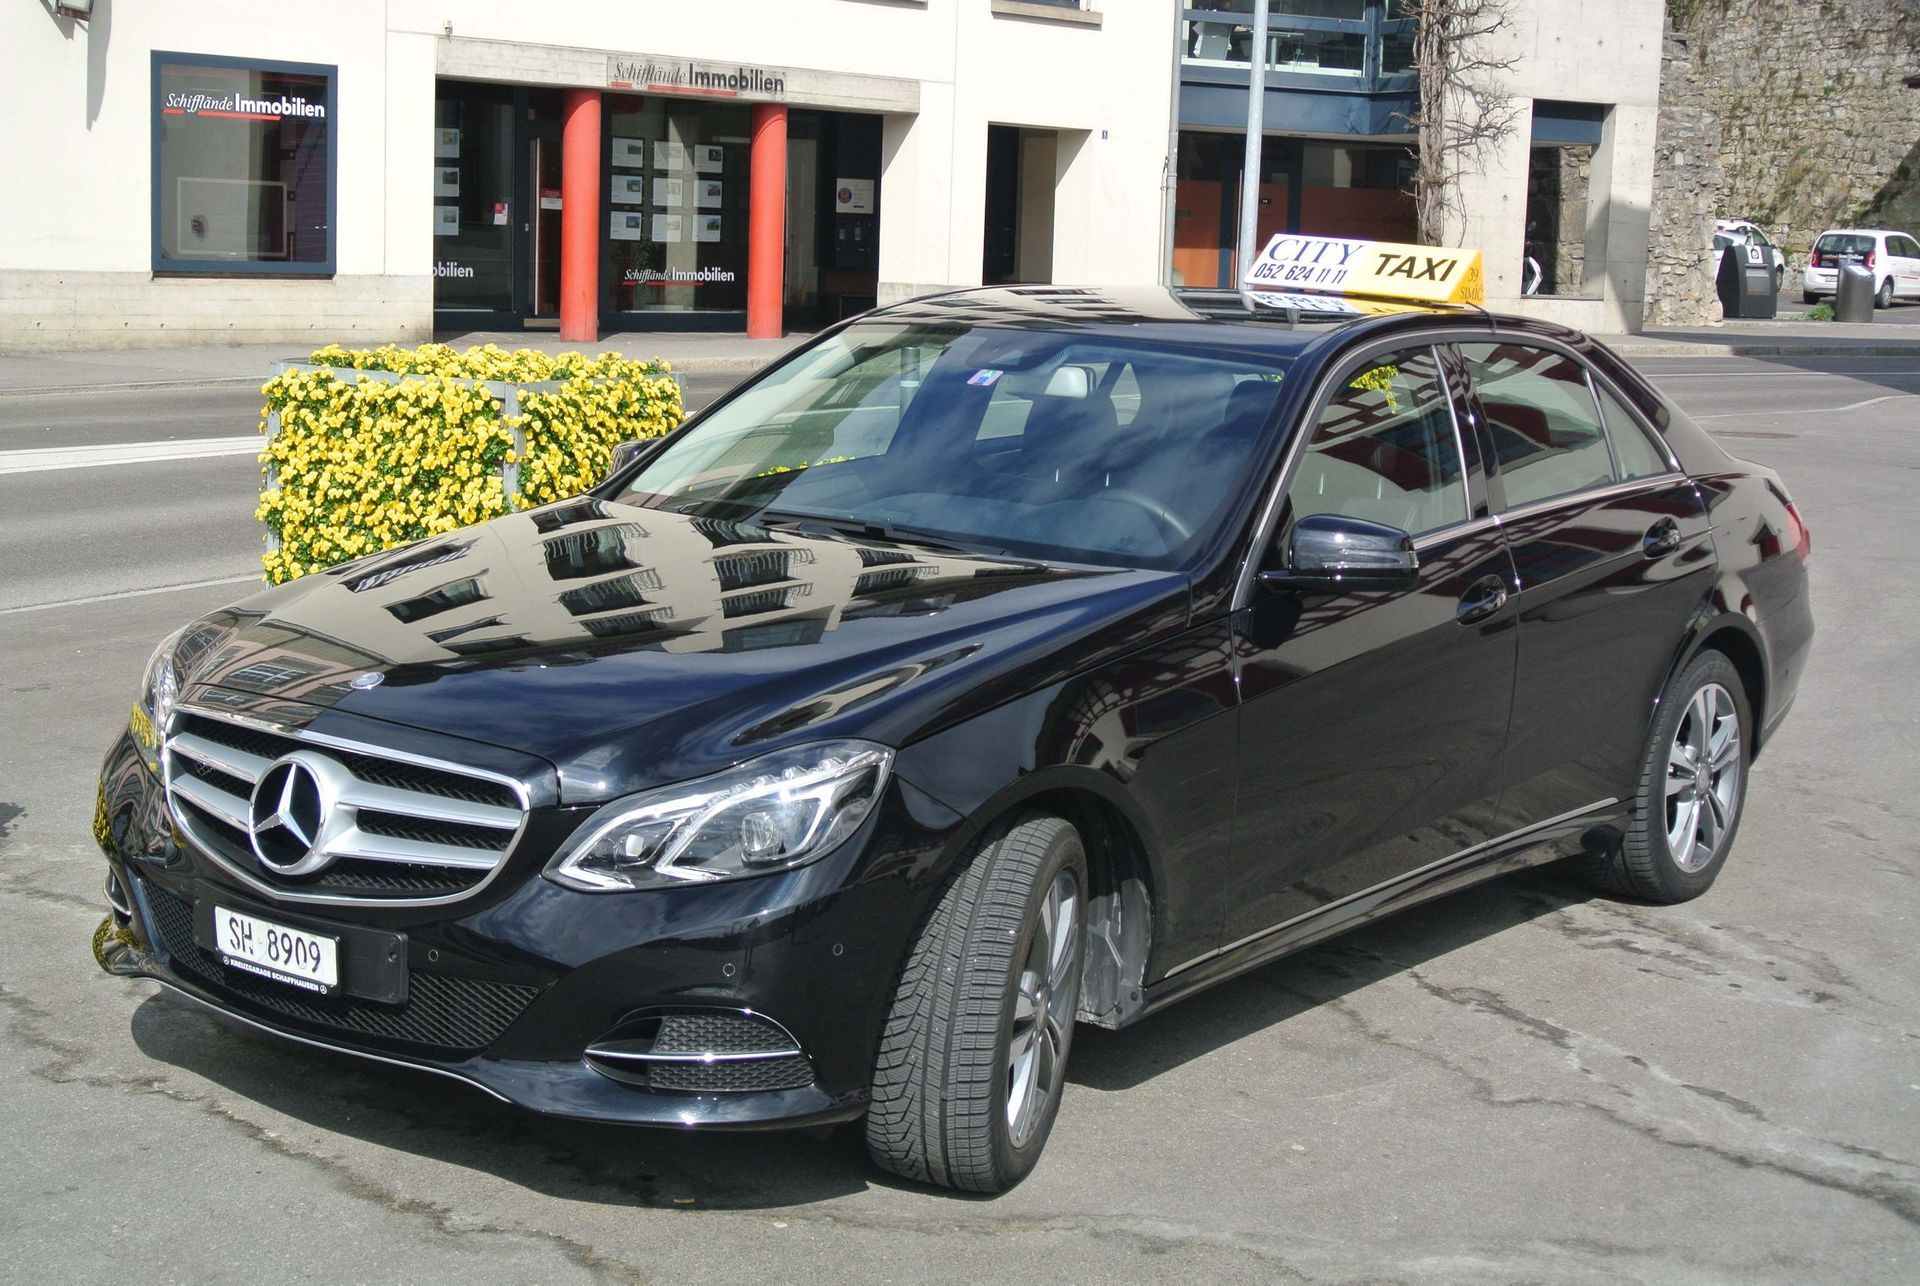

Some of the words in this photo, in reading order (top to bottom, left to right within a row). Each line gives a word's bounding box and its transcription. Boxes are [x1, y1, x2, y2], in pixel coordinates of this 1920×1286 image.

[613, 62, 687, 85] Schifflände
[688, 62, 785, 93] Immobilien
[166, 92, 233, 113] Schifflände
[235, 92, 325, 118] Immobilien
[1268, 238, 1365, 266] CITY
[624, 268, 671, 284] Schifflände
[672, 266, 736, 282] Immobilien
[1254, 262, 1285, 280] 052
[1284, 265, 1316, 282] 624
[1315, 267, 1332, 283] 11
[1331, 269, 1349, 284] 11
[1374, 253, 1458, 282] TAXI
[1468, 267, 1479, 282] 39
[229, 916, 254, 956] SH
[267, 928, 321, 974] 8909
